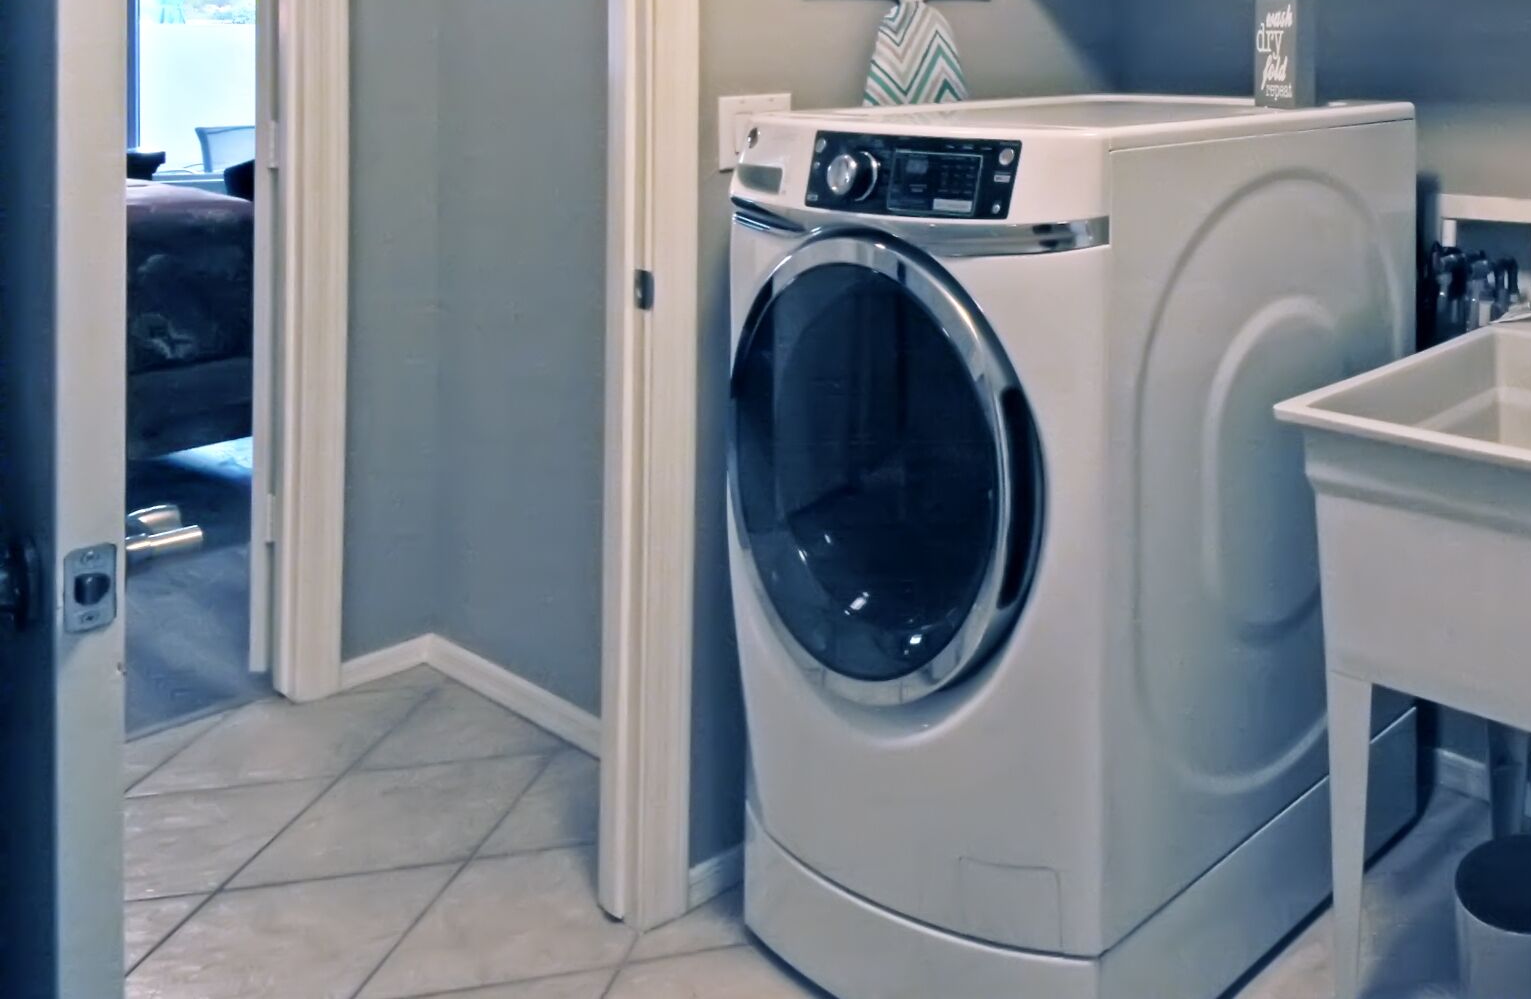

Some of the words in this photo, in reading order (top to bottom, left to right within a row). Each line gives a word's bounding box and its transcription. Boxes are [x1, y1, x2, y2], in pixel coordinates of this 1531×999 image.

[1265, 3, 1293, 28] wash
[1256, 22, 1284, 60] dry
[1261, 55, 1288, 90] fold
